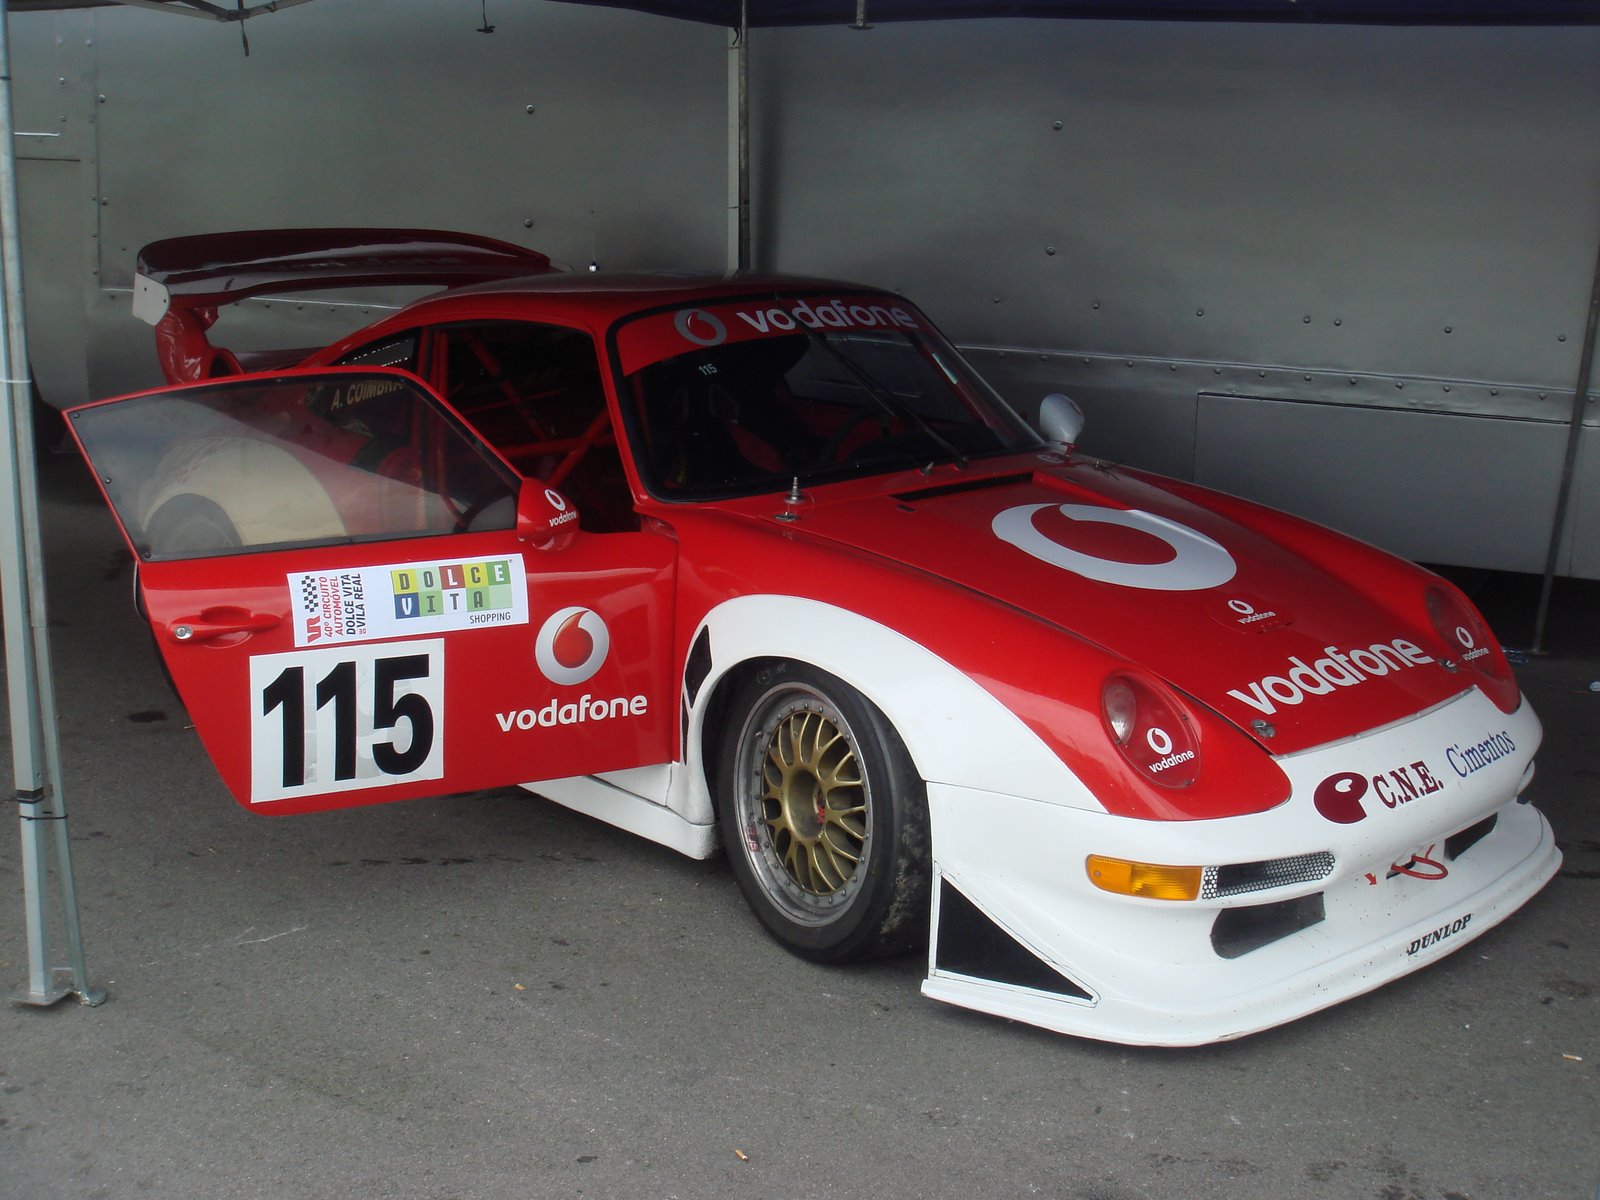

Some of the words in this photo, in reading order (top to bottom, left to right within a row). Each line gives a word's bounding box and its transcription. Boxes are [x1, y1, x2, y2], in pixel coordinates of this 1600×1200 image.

[736, 300, 919, 333] vodafone
[698, 363, 717, 376] 115
[340, 574, 354, 597] VITA
[351, 573, 364, 600] REAL
[398, 564, 505, 590] DOLCE
[318, 576, 332, 619] CIRCUITO
[330, 576, 344, 636] AUTOMÓVEL
[401, 591, 483, 616] VITA
[344, 600, 356, 635] DOLCE
[355, 603, 366, 628] VILA
[469, 611, 511, 624] SHOPPING
[1226, 638, 1435, 715] vodafone
[263, 653, 434, 788] 115
[495, 694, 648, 732] vodafone
[1149, 750, 1195, 773] vodafone
[1372, 760, 1444, 809] C.N.E.
[1446, 730, 1516, 778] Cimentos
[1406, 913, 1473, 956] DUNLOP
